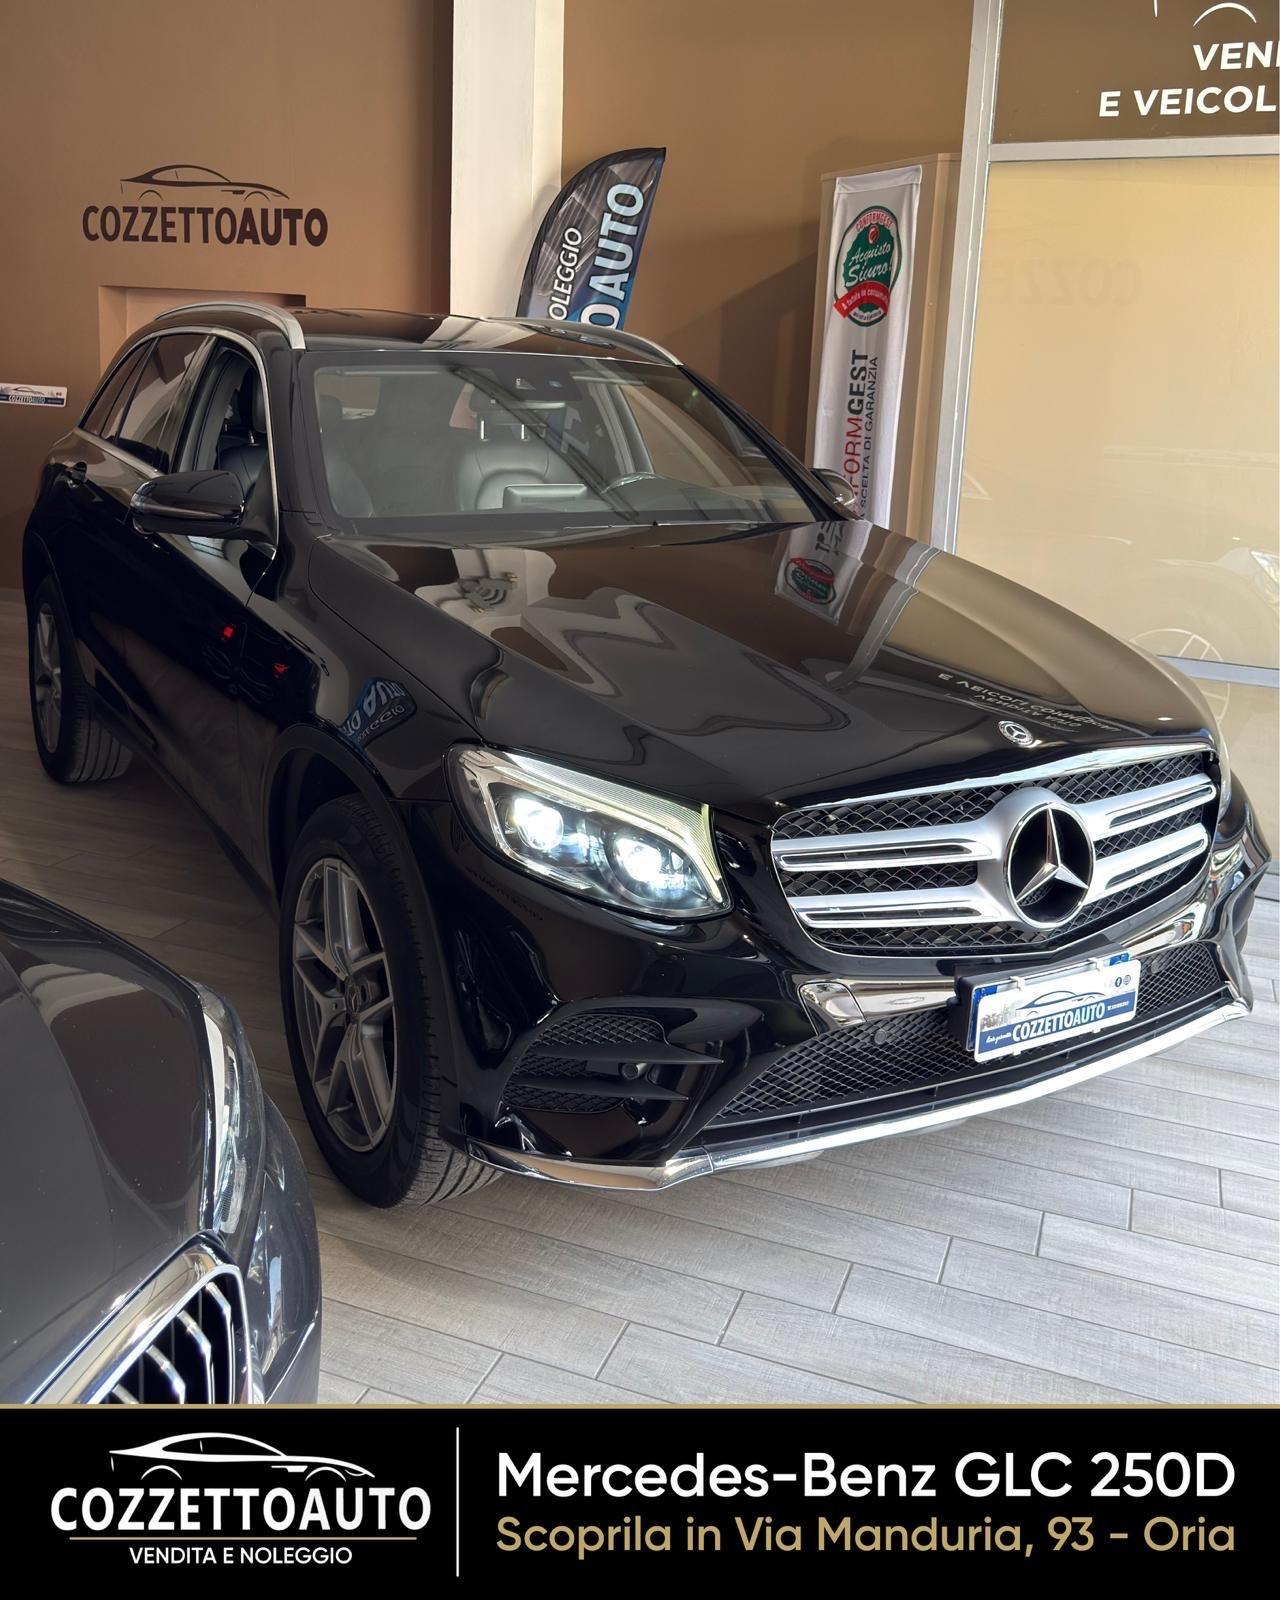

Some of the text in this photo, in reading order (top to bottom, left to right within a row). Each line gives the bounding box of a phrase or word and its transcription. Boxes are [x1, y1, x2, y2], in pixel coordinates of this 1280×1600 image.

[1193, 41, 1279, 70] VEN
[1099, 85, 1277, 117] E VEICOL
[82, 205, 328, 247] COZZETTOAUTO
[849, 242, 891, 266] Acquisto
[864, 356, 878, 432] GARANZIA
[1012, 1002, 1105, 1042] COZZETTOAUTO
